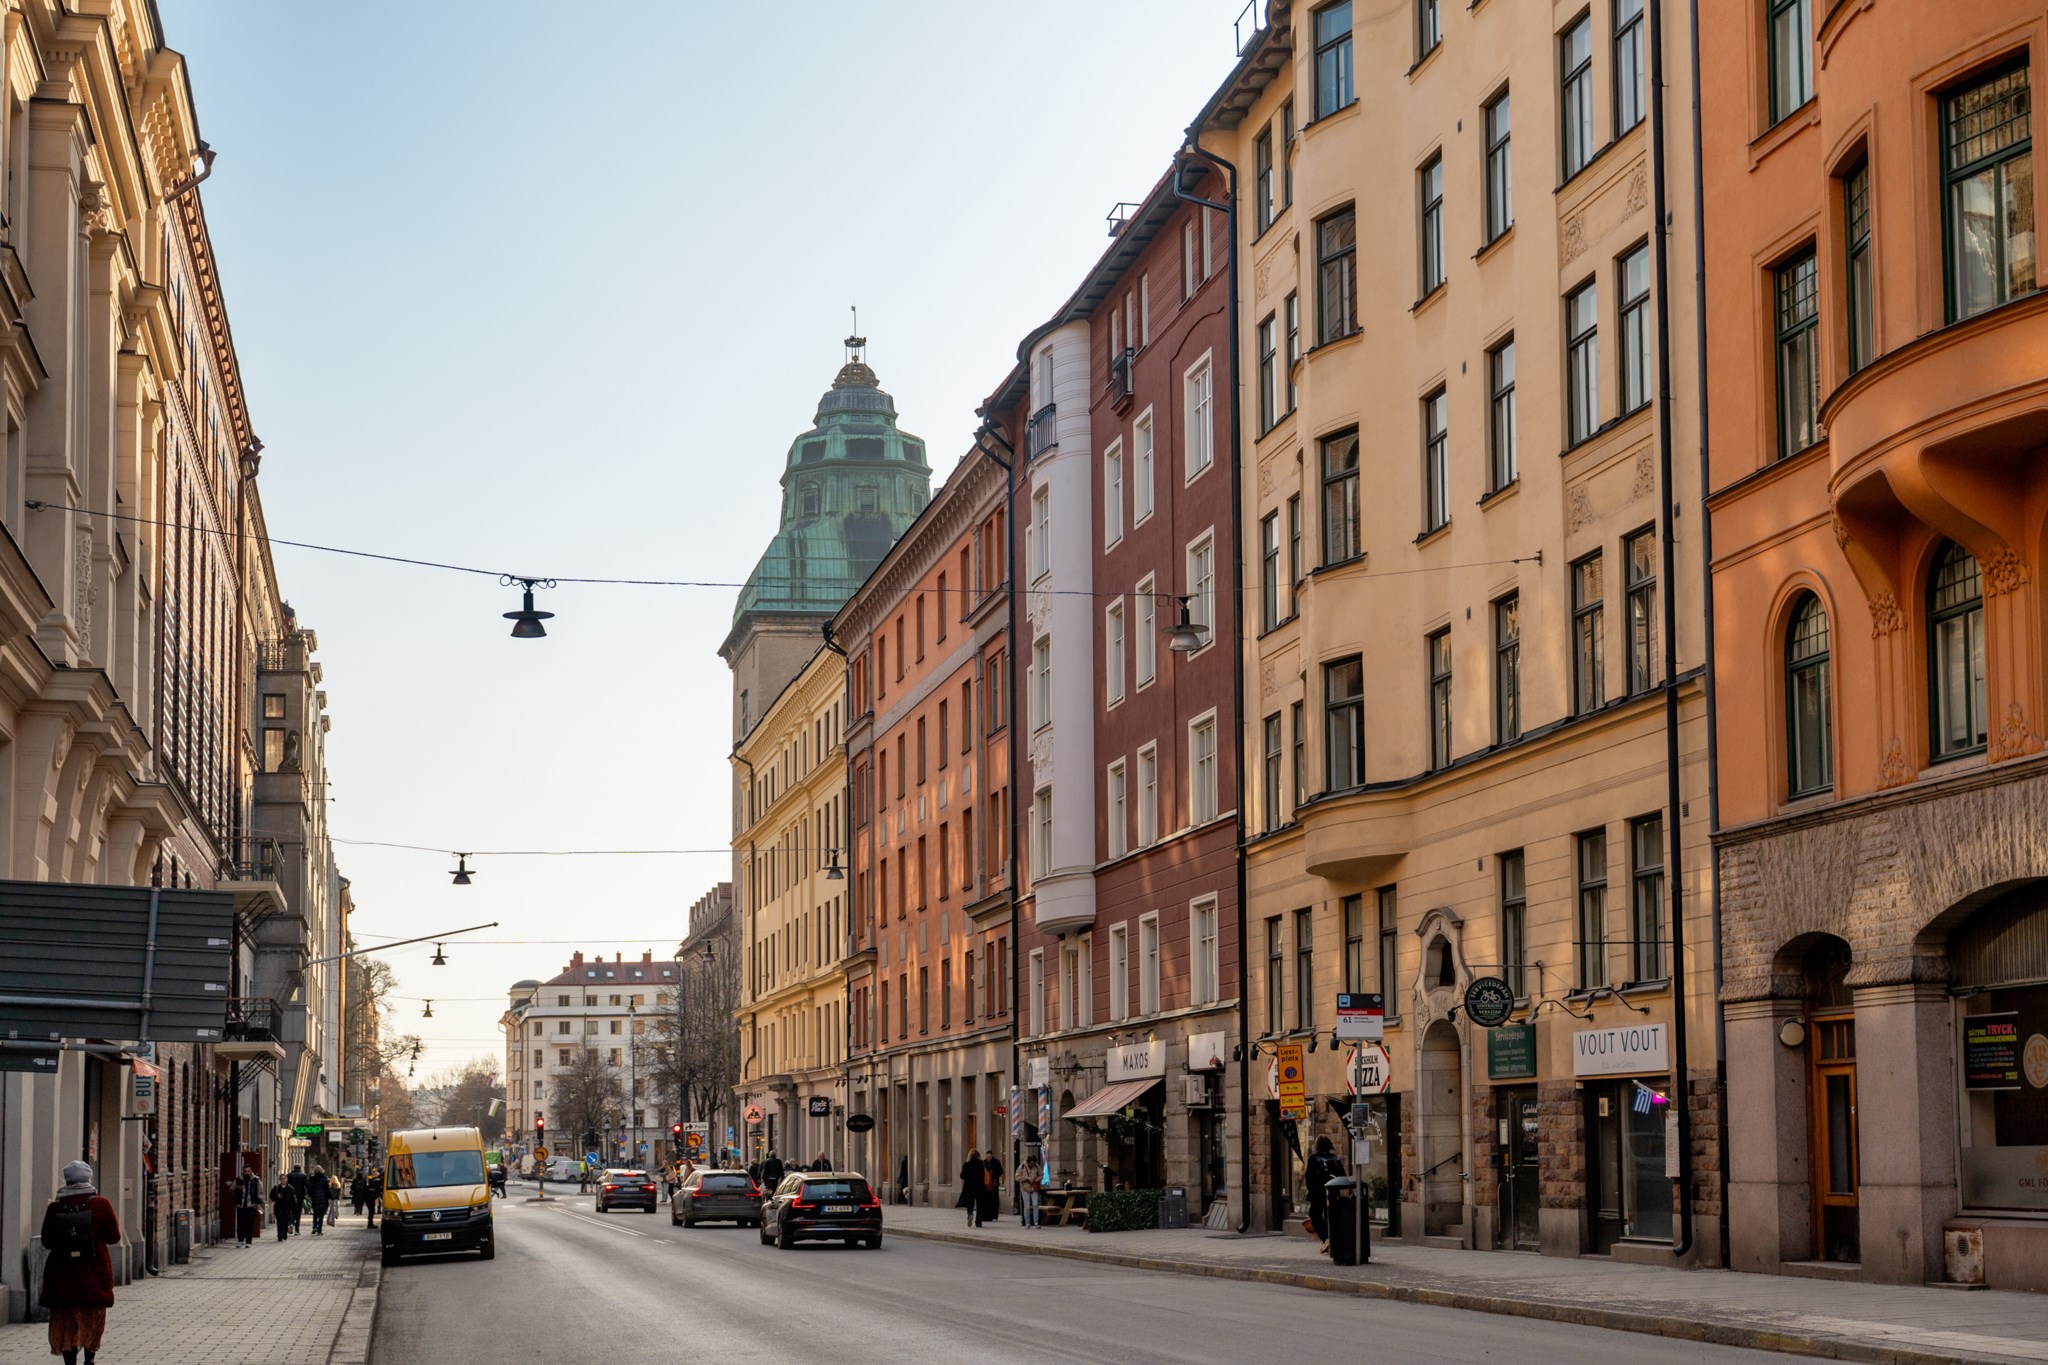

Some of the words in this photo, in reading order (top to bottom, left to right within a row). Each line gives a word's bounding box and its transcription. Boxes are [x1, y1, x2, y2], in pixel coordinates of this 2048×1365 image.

[1987, 1023, 2013, 1035] TRYCK
[1579, 1032, 1615, 1055] VOUT
[1620, 1028, 1659, 1052] VOUT
[1123, 1052, 1148, 1070] MAXOS
[295, 1125, 322, 1135] coop
